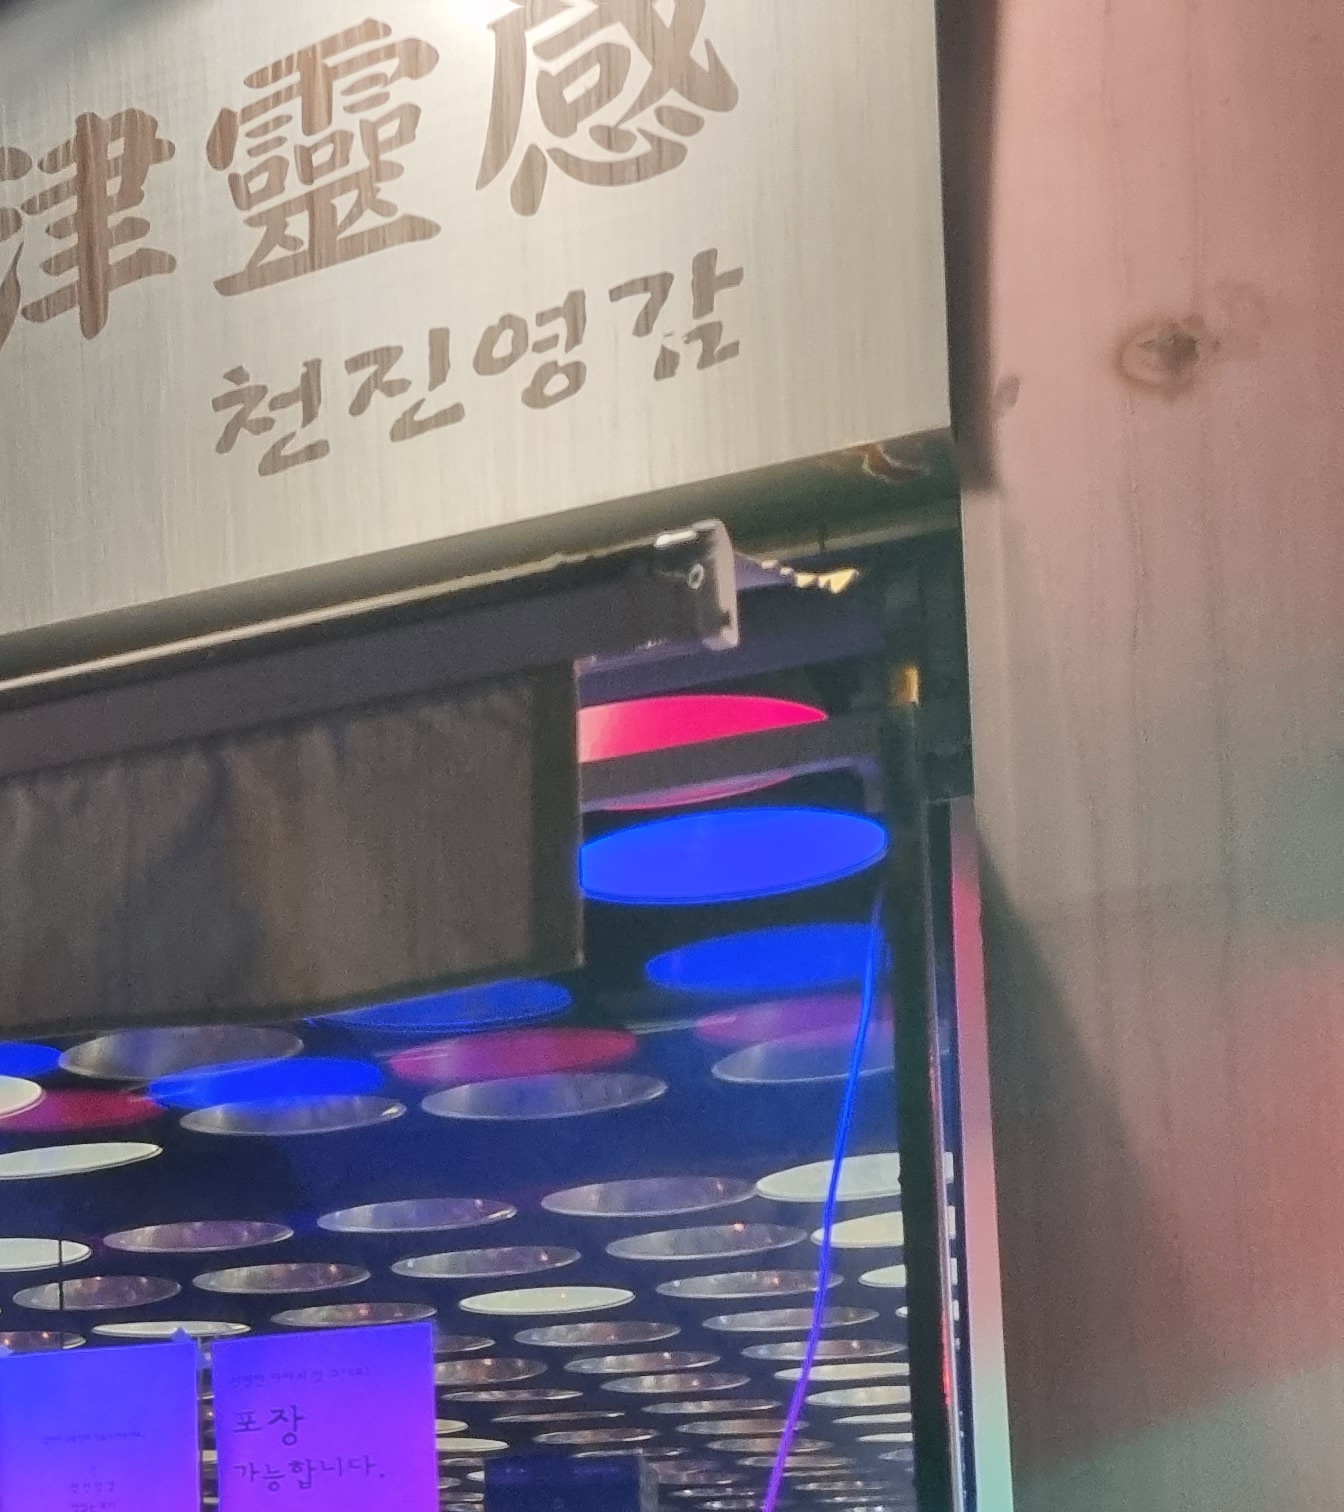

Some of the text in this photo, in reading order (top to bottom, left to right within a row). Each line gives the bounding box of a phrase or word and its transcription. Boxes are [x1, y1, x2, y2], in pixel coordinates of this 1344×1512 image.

[210, 249, 745, 475] 천진영감
[231, 1403, 306, 1447] 포장
[232, 1454, 386, 1492] 가능합니다.
